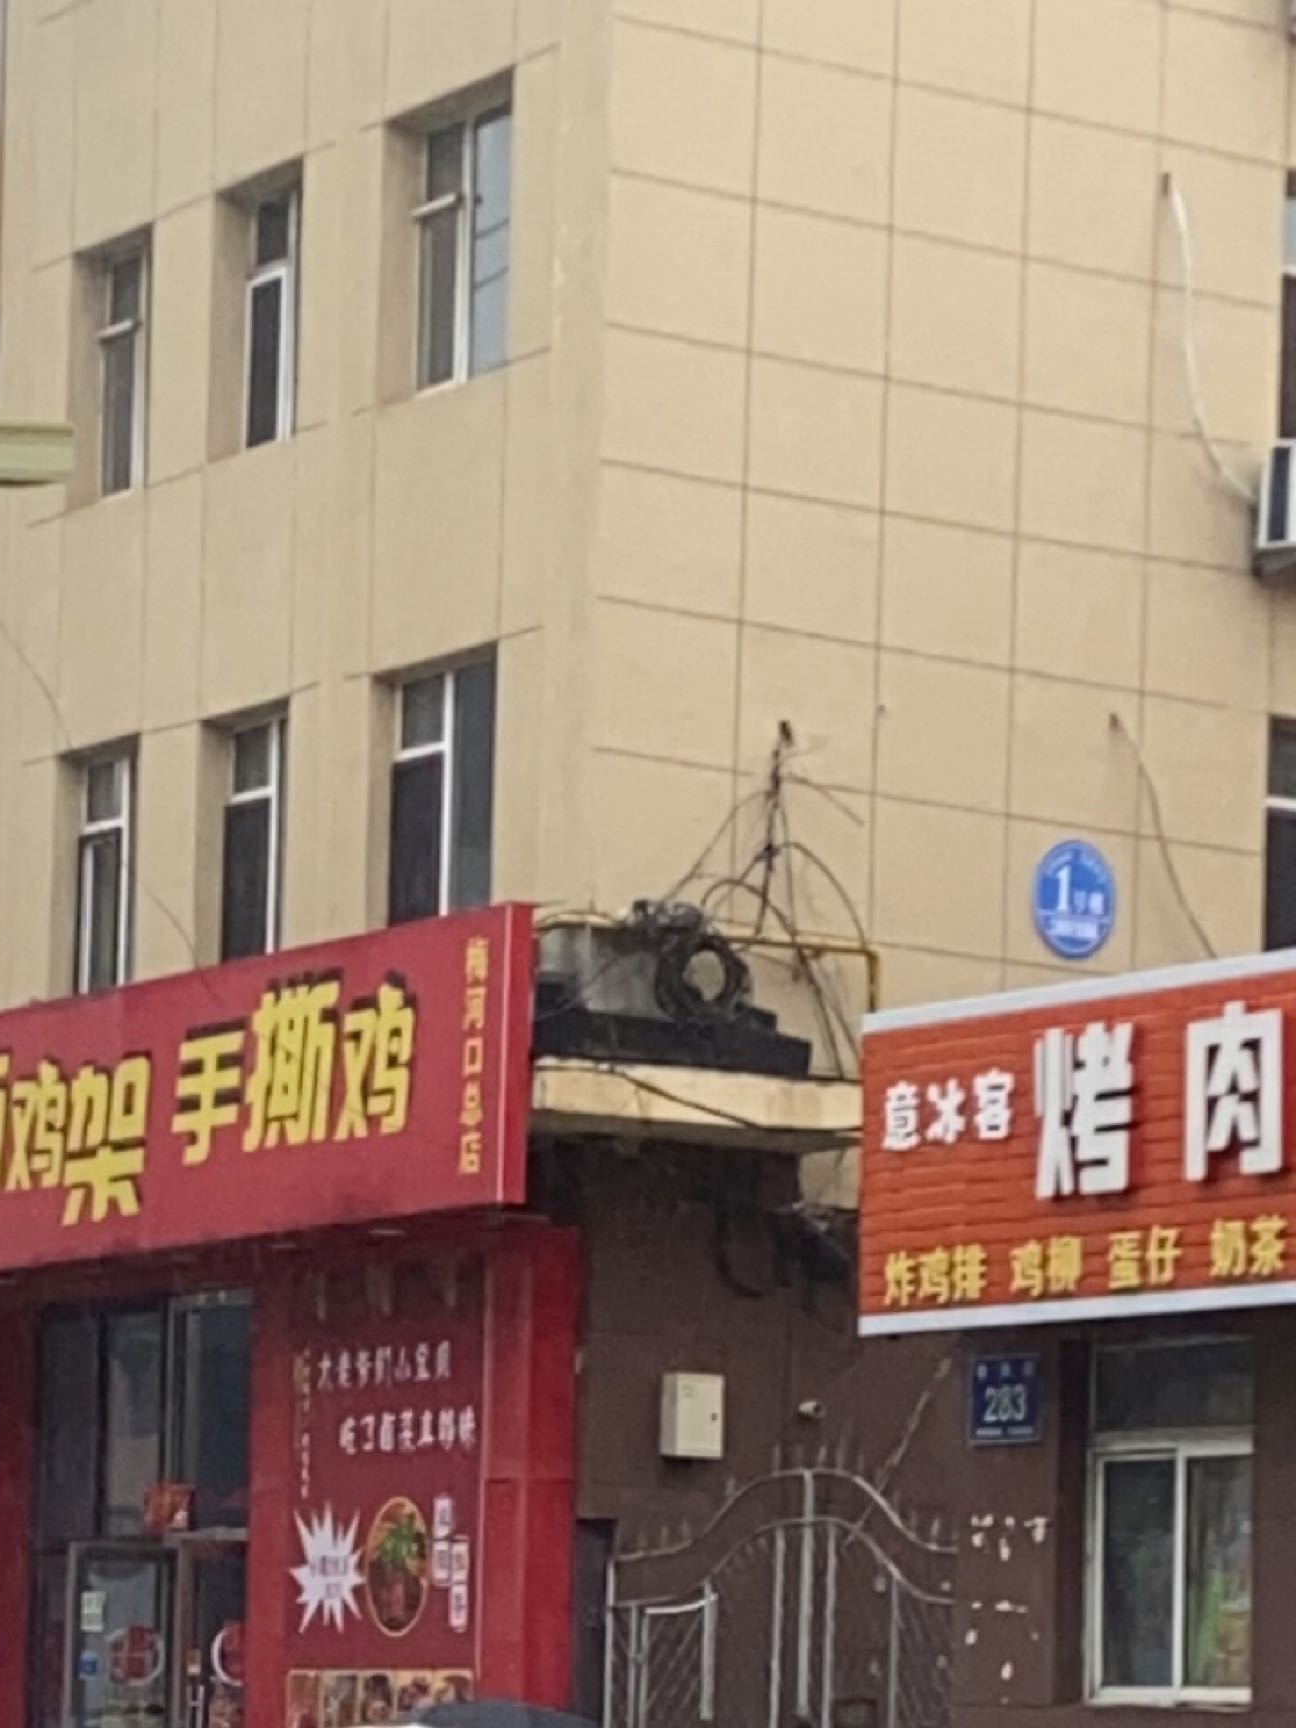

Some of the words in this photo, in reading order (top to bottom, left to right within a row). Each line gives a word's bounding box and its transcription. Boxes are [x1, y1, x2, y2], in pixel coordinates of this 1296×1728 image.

[171, 980, 413, 1167] 手撕鸡
[882, 1067, 1015, 1151] 意冰客
[1033, 1000, 1283, 1200] 烤肉
[885, 1244, 988, 1306] 炸鸡排
[1108, 1225, 1182, 1289] 蛋仔
[1210, 1214, 1287, 1277] 奶茶
